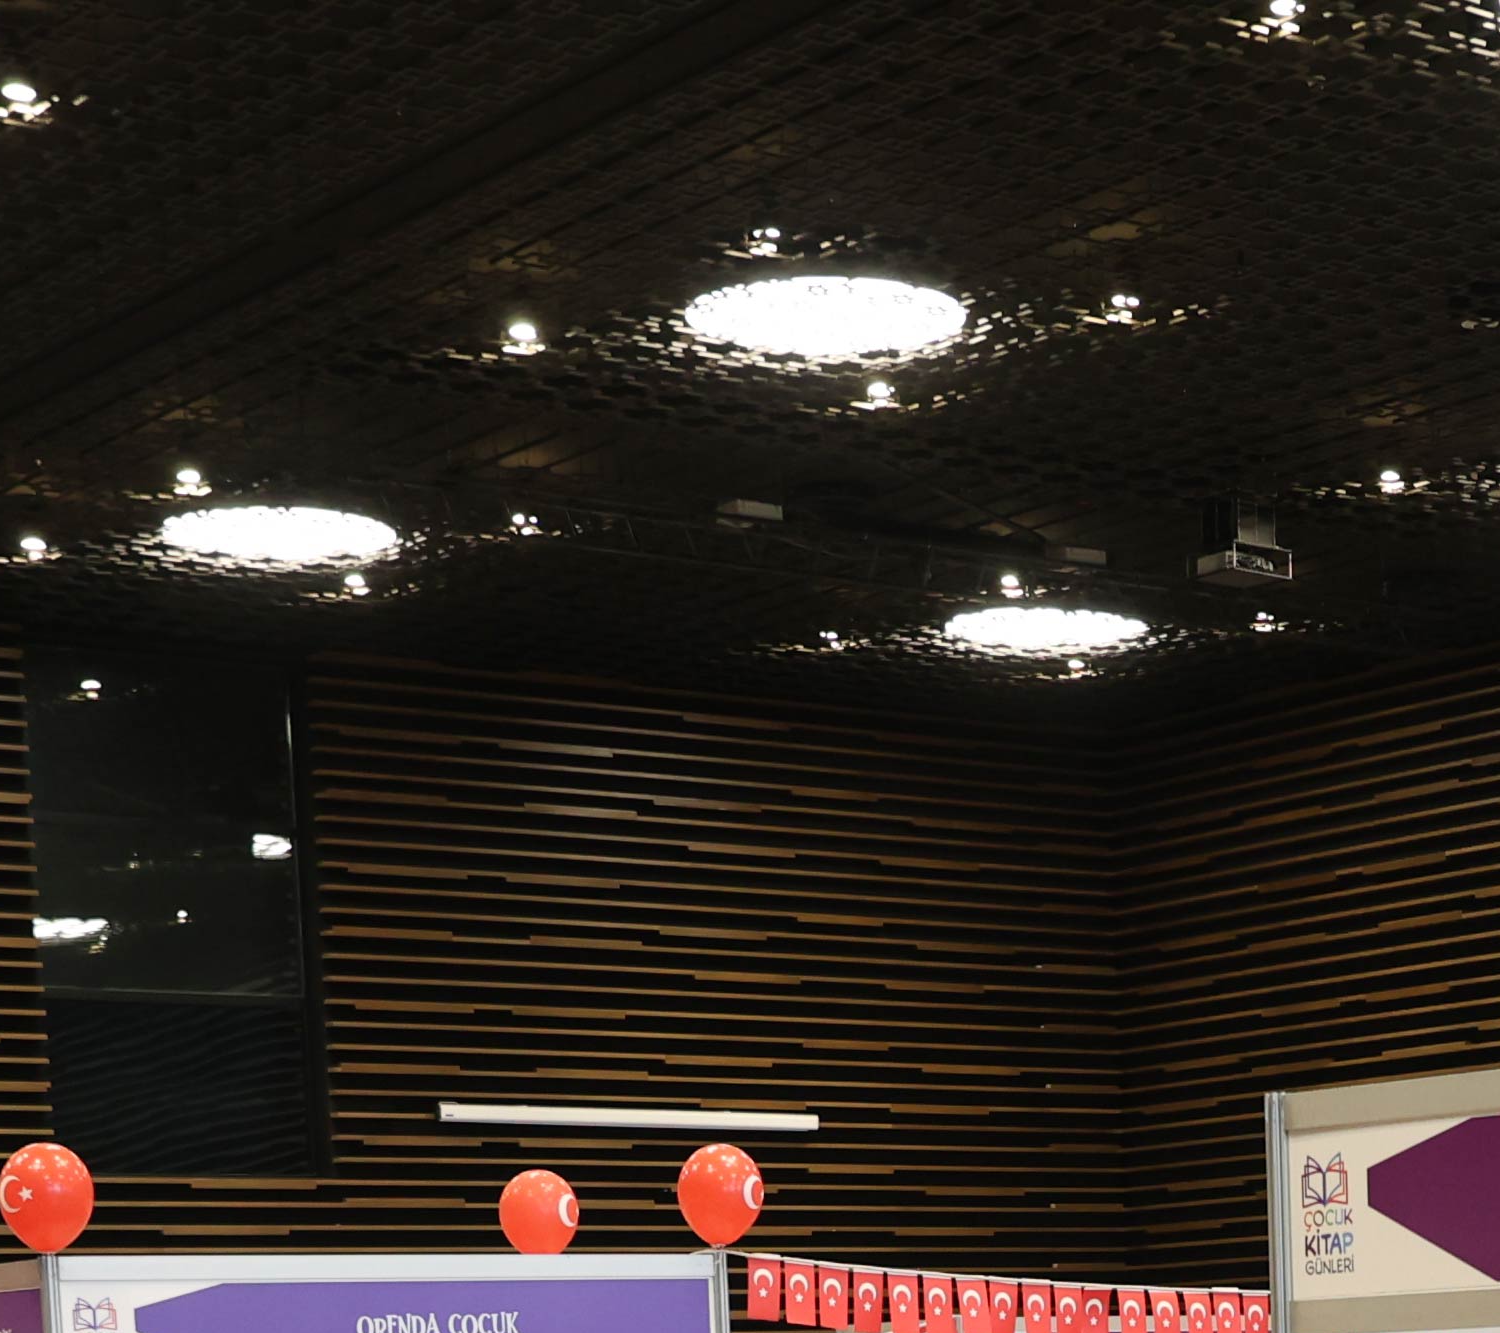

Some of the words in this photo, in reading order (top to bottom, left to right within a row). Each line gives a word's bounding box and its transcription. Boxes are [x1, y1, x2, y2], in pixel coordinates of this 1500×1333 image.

[1303, 1208, 1353, 1233] ÇOCUK
[1304, 1229, 1354, 1258] KİTAP
[1305, 1254, 1354, 1276] GÜNLERİ
